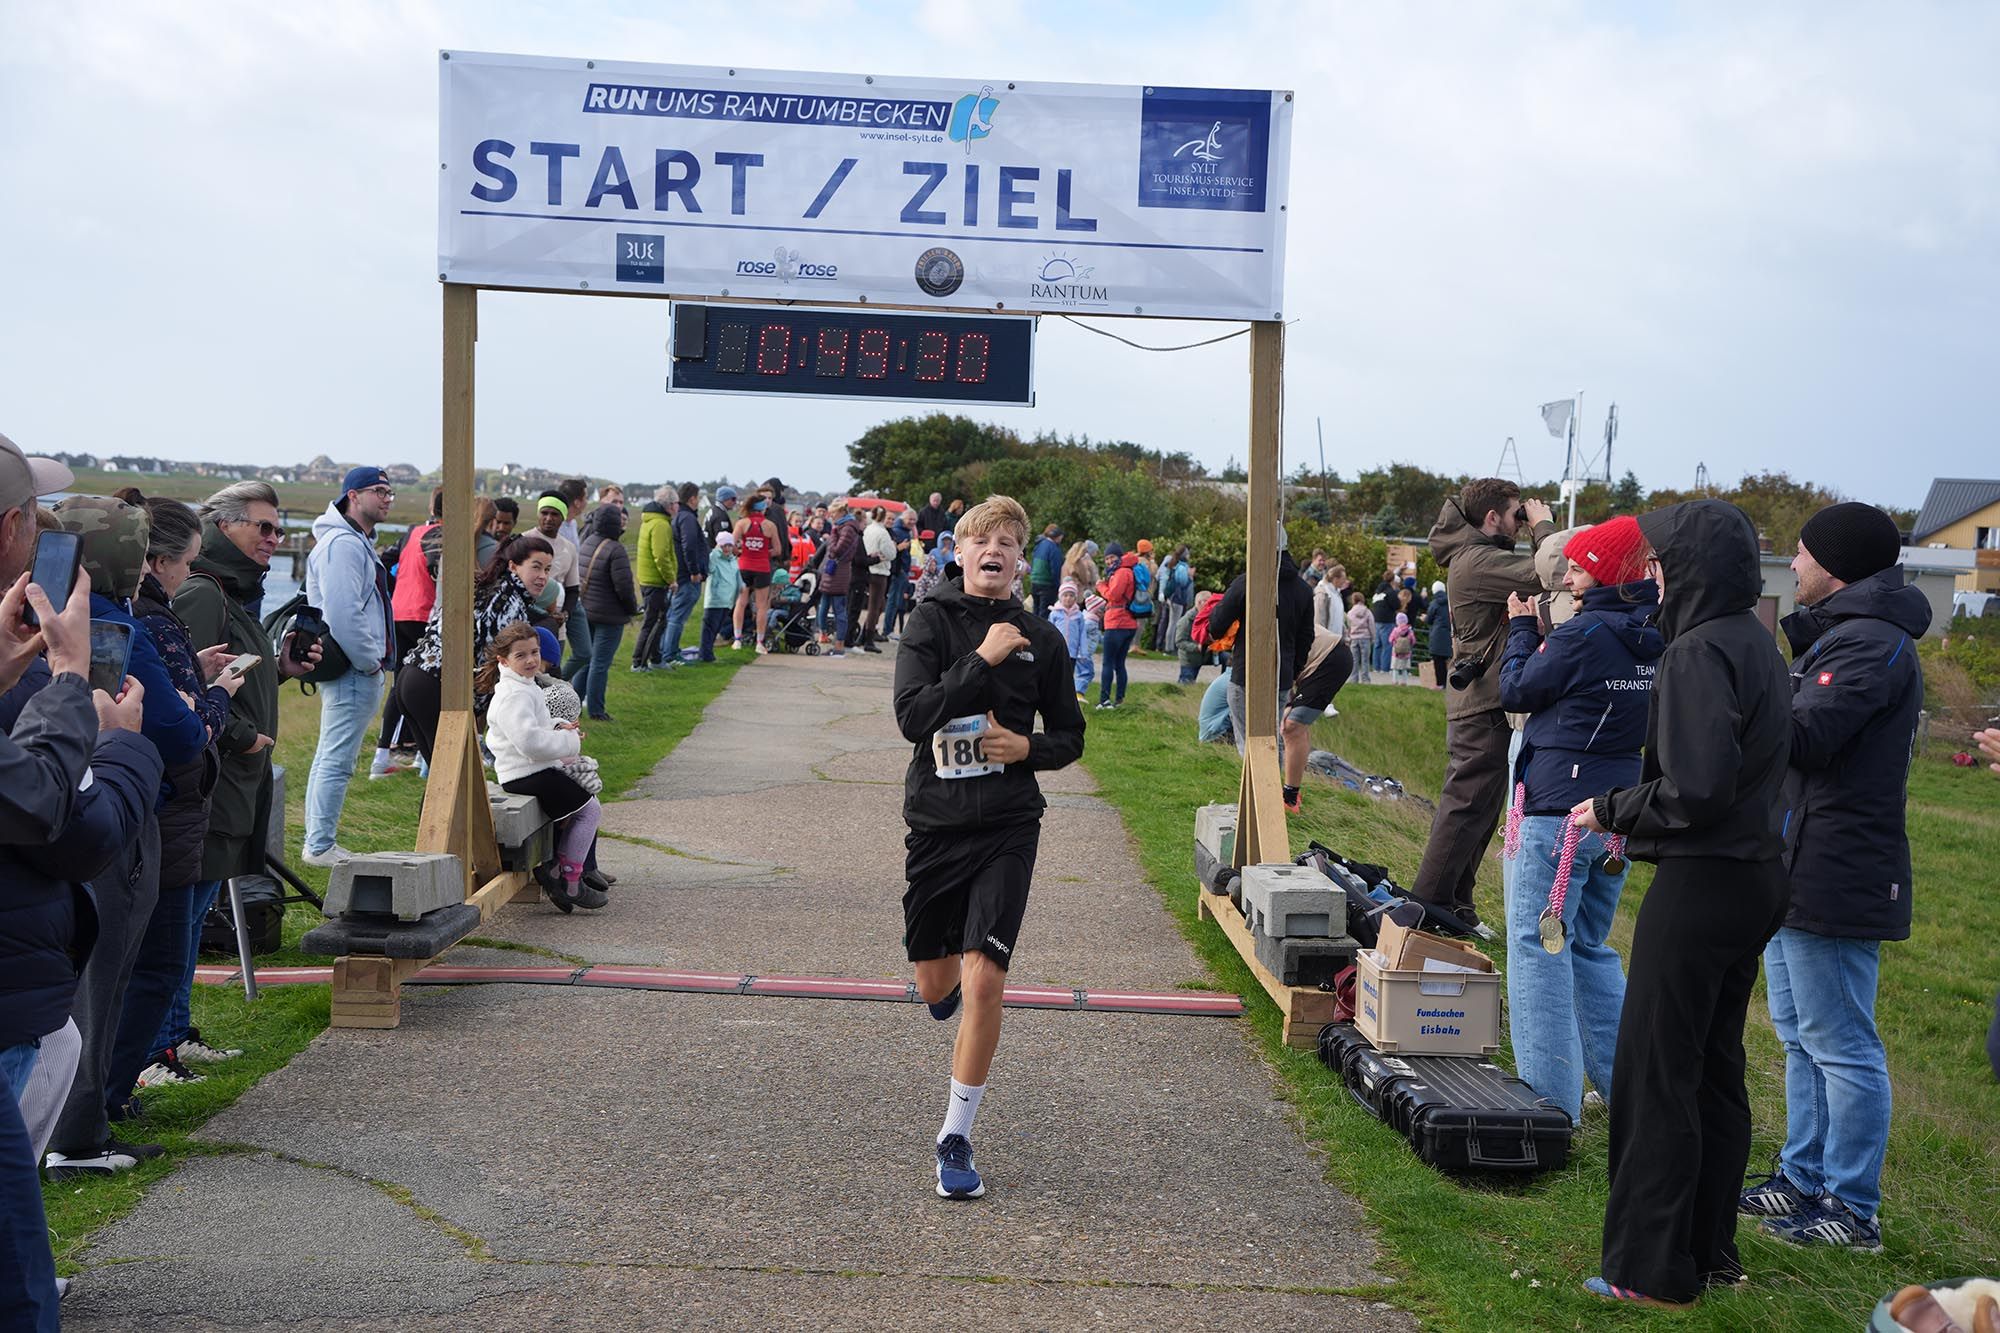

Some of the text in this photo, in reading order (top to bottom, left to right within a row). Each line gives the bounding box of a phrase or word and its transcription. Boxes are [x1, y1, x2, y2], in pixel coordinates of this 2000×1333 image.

[588, 86, 947, 127] RUN UMS RANTUMBECKEN
[859, 131, 945, 145] www.insel-sylt.de
[1191, 162, 1218, 174] SYLT
[470, 139, 764, 216] START
[900, 161, 1098, 232] ZIEL
[1152, 174, 1254, 187] TOURISMUS-SERVICE
[1169, 186, 1236, 198] INSEL-SYLT.DE
[736, 260, 838, 277] rose rose
[1031, 283, 1109, 300] RANTUM
[1635, 665, 1656, 675] TEAM
[1416, 1008, 1465, 1018] Fundsachen
[1420, 1024, 1461, 1036] Eisbahn
